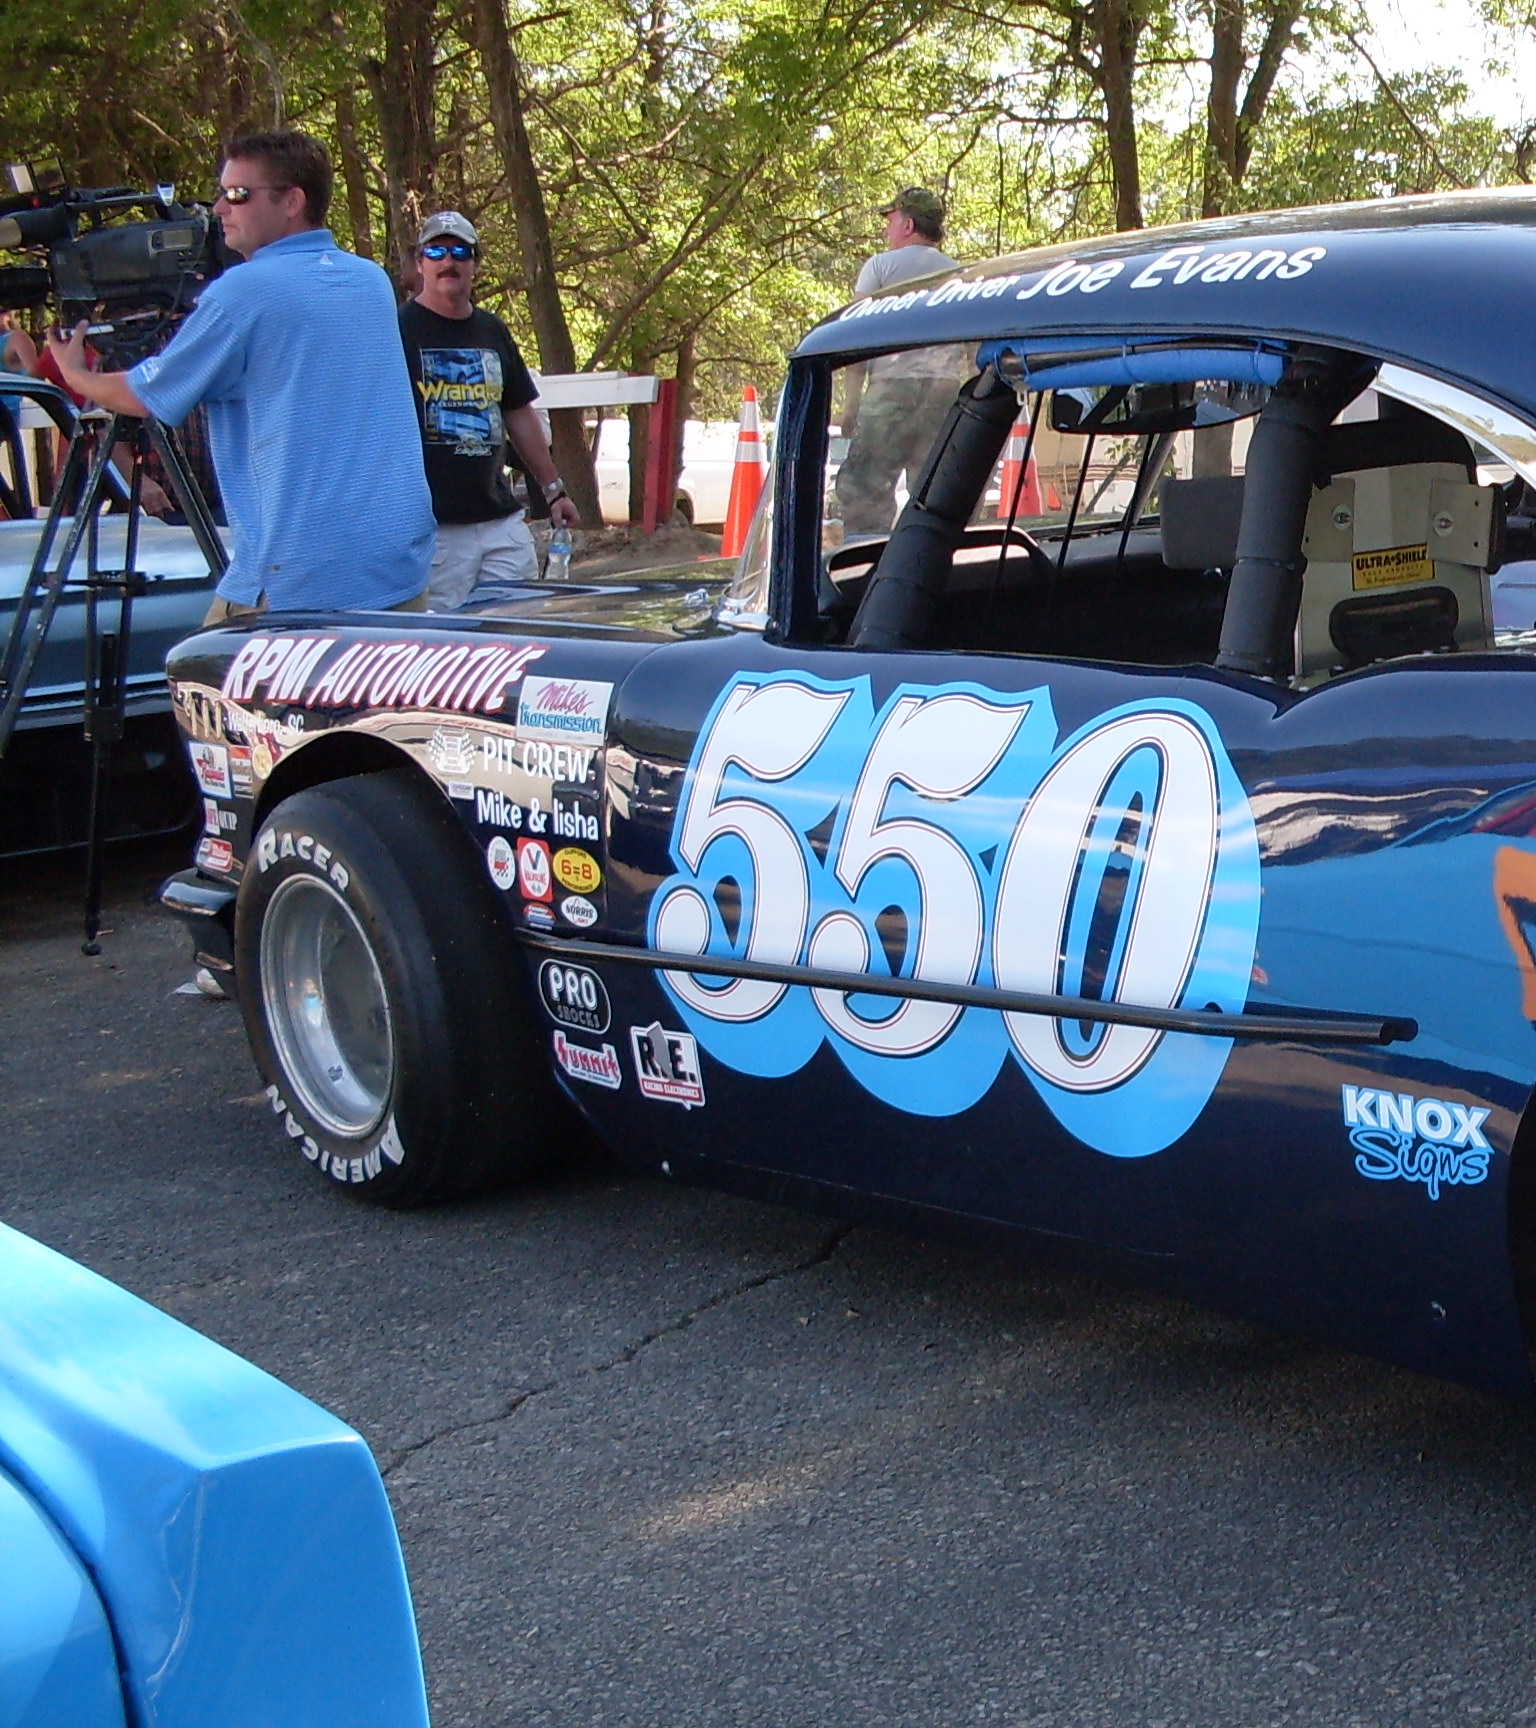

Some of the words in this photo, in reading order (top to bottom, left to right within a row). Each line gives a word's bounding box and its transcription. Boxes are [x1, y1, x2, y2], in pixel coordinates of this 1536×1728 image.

[839, 288, 924, 322] Owner
[926, 275, 1020, 307] Driver
[1017, 259, 1126, 300] Joe
[1130, 245, 1327, 289] Evans
[416, 380, 503, 411] Wrang
[220, 637, 338, 702] RPM
[305, 640, 550, 715] AUTOMOTIVE
[287, 713, 305, 736] SC
[483, 736, 516, 775] PIT
[522, 740, 595, 784] CREW
[476, 789, 523, 829] Mike
[528, 797, 548, 834] &
[257, 826, 351, 893] RACER
[653, 680, 1222, 1095] 550
[548, 964, 598, 1012] PRO
[557, 1004, 601, 1029] SHOCKS
[266, 1083, 406, 1185] AMERICAN
[1342, 1084, 1492, 1150] KNOX
[1349, 1129, 1490, 1200] Signs
